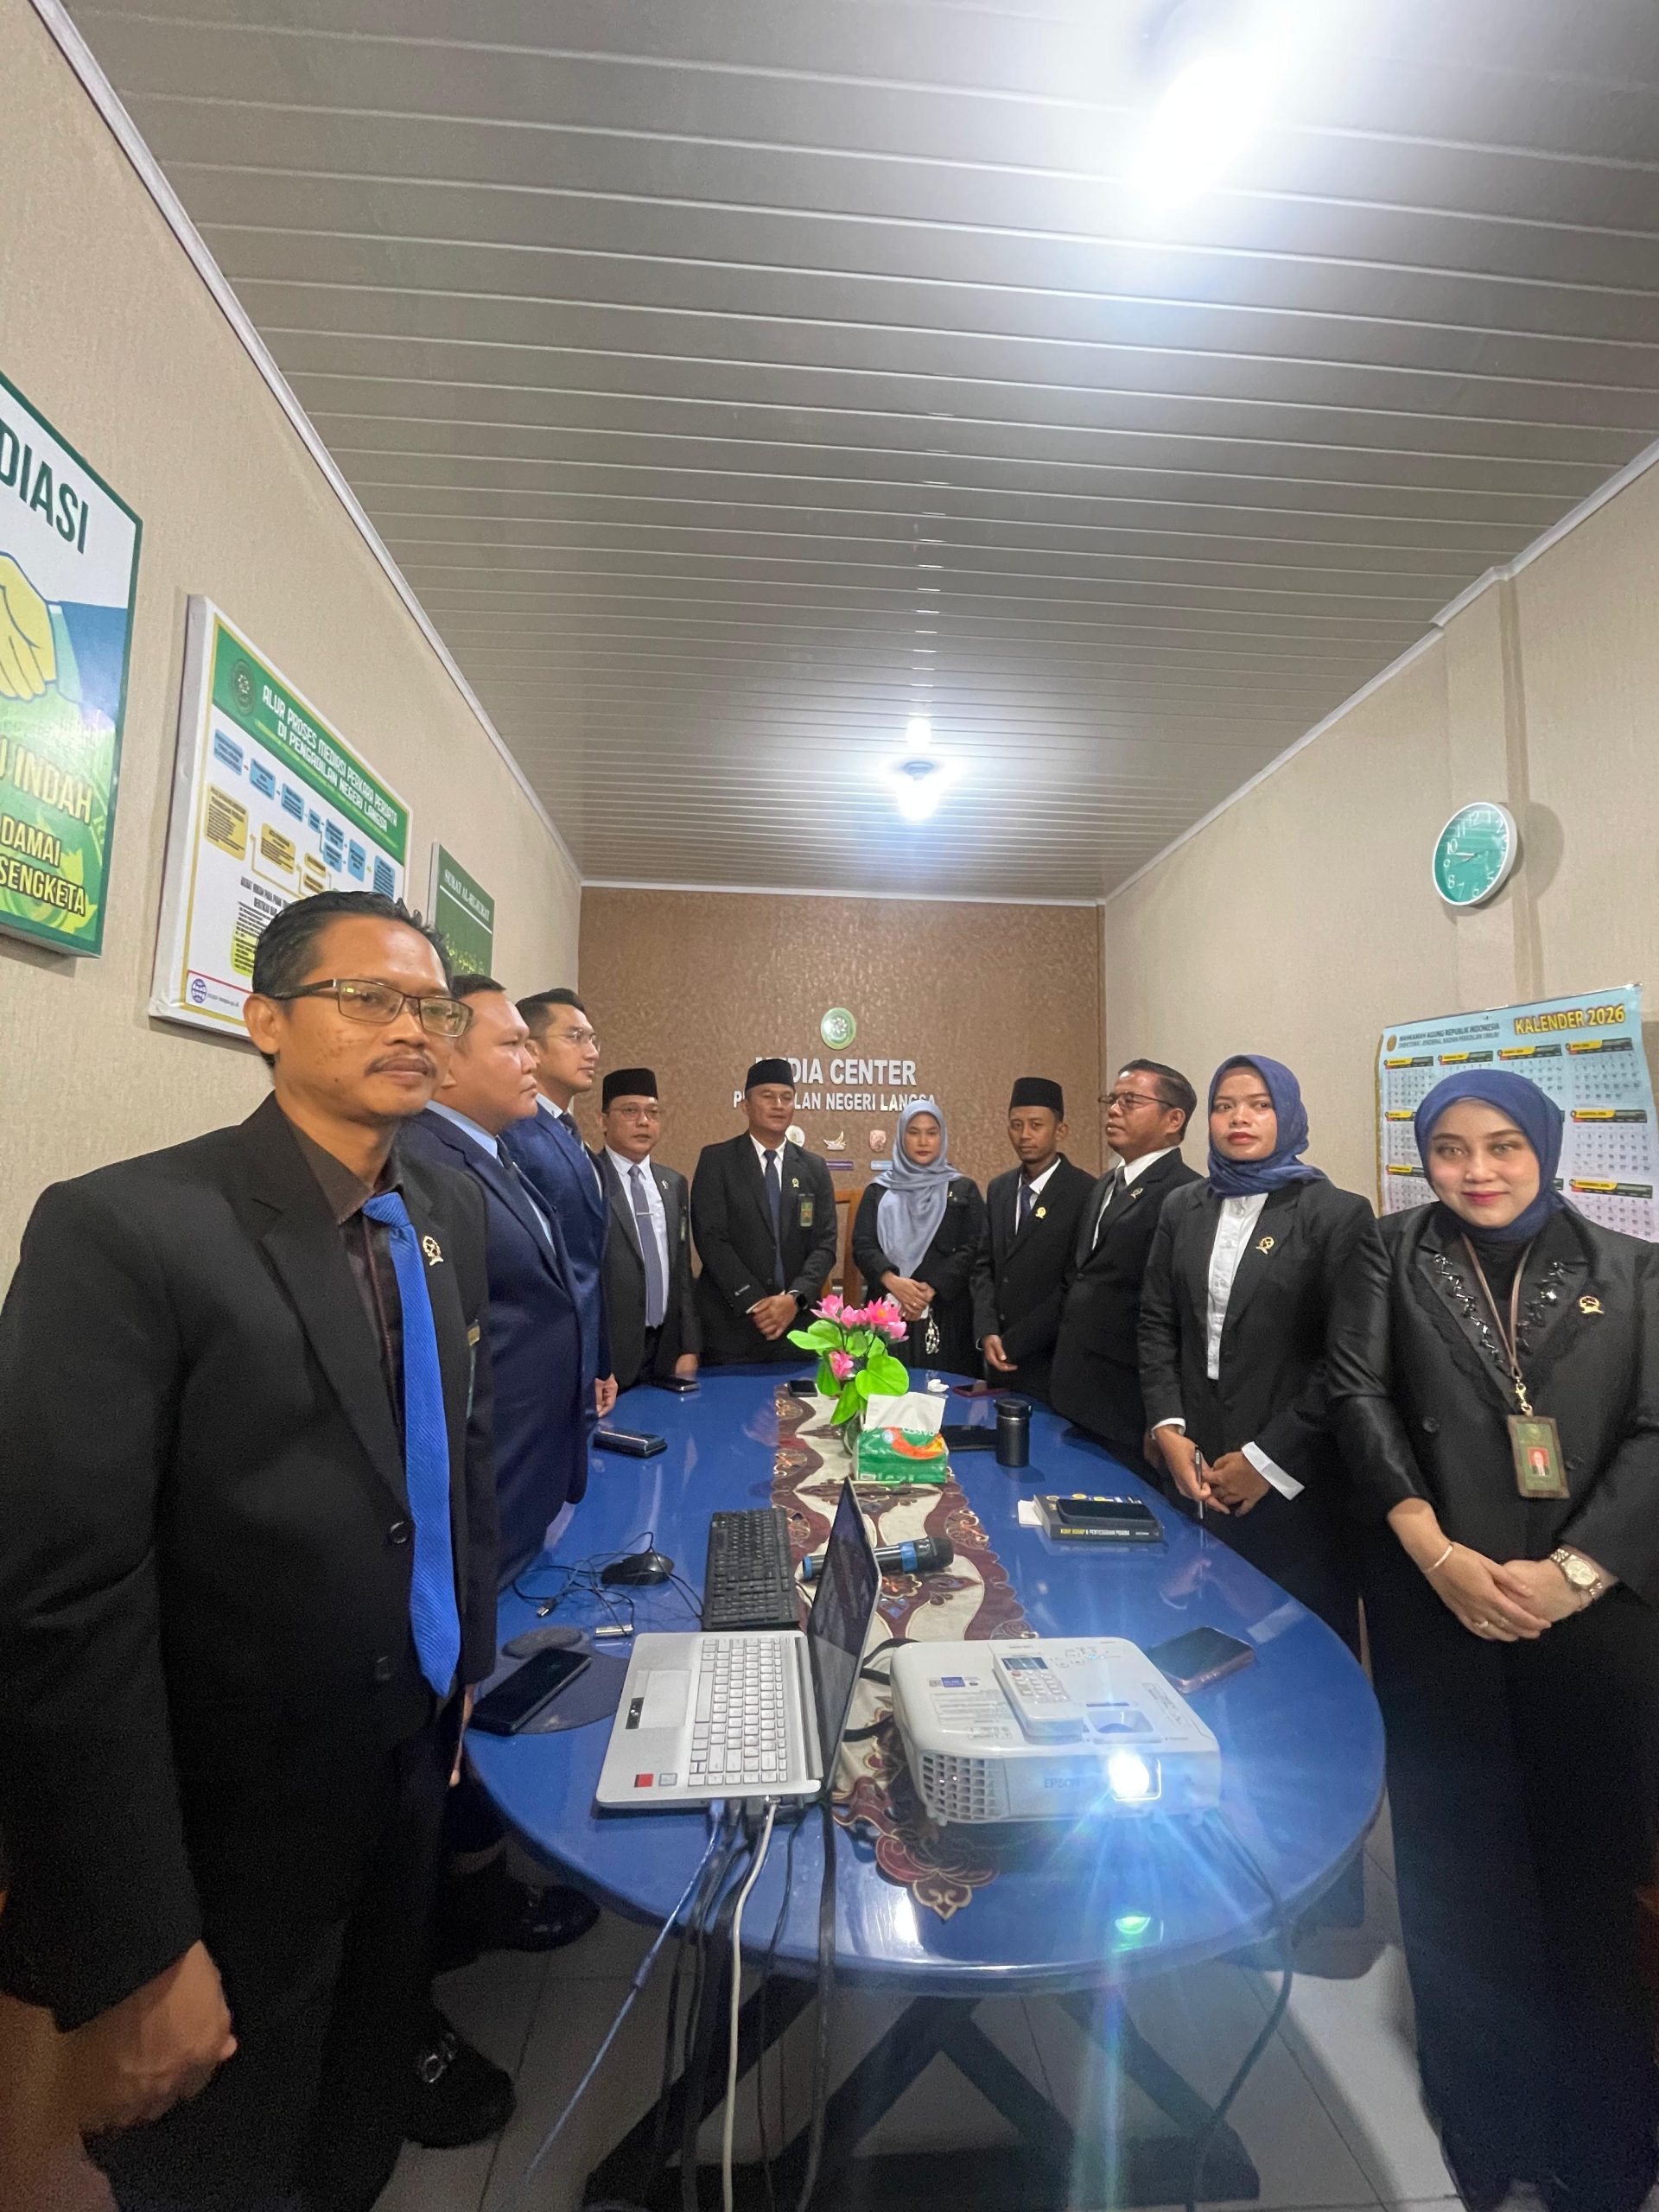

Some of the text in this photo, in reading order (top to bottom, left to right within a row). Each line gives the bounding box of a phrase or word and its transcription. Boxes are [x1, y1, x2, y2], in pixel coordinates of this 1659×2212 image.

[263, 684, 286, 720] ALUR
[287, 708, 317, 749] PROSES
[277, 721, 288, 741] DI
[289, 733, 338, 786] PENGADILAN
[339, 777, 363, 810] NEGERI
[13, 744, 93, 824] INDAH
[1, 814, 61, 868] DAMAI
[1457, 822, 1465, 838] 11
[1446, 838, 1459, 855] 10
[0, 854, 86, 917] SENGKETA
[1447, 874, 1455, 889] 8
[1514, 1004, 1625, 1035] KALENDER 2026
[755, 1057, 918, 1086] DIA CENTER
[825, 1092, 876, 1111] NEGERI
[1045, 1777, 1080, 1789] EPSON
